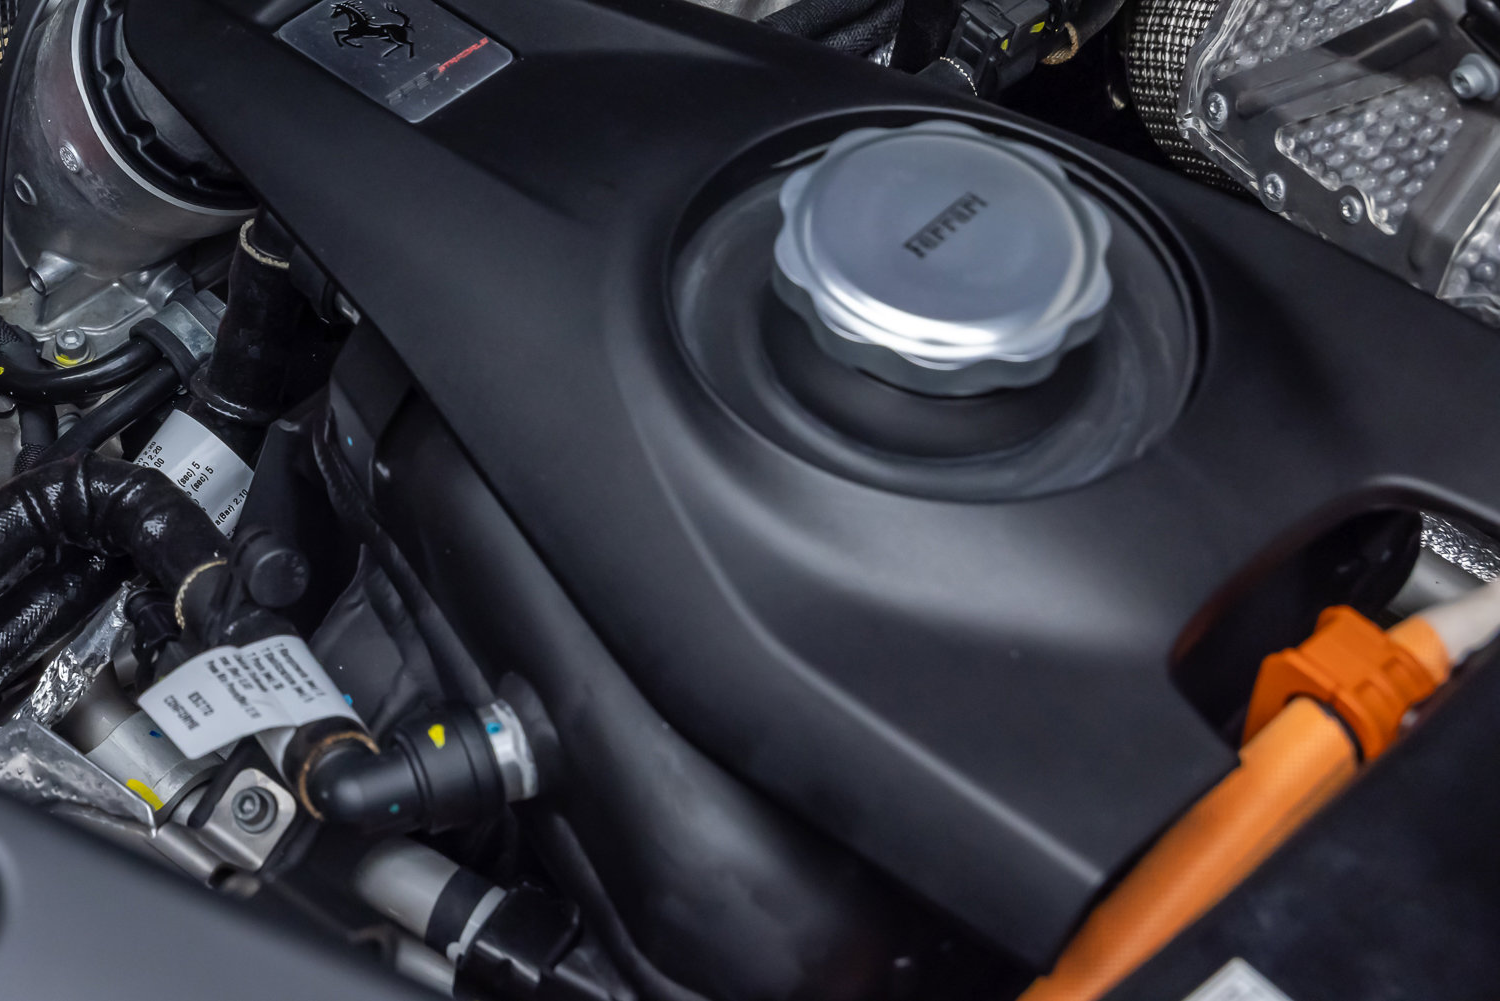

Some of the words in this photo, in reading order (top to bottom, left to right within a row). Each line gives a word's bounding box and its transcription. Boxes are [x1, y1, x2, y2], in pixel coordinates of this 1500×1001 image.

[901, 191, 989, 260] Ferrari
[147, 445, 162, 461] 2,20
[177, 467, 196, 488] (sec)
[192, 461, 201, 470] 5
[190, 473, 209, 492] (sec)
[205, 466, 214, 475] 5
[233, 488, 248, 505] 2,10
